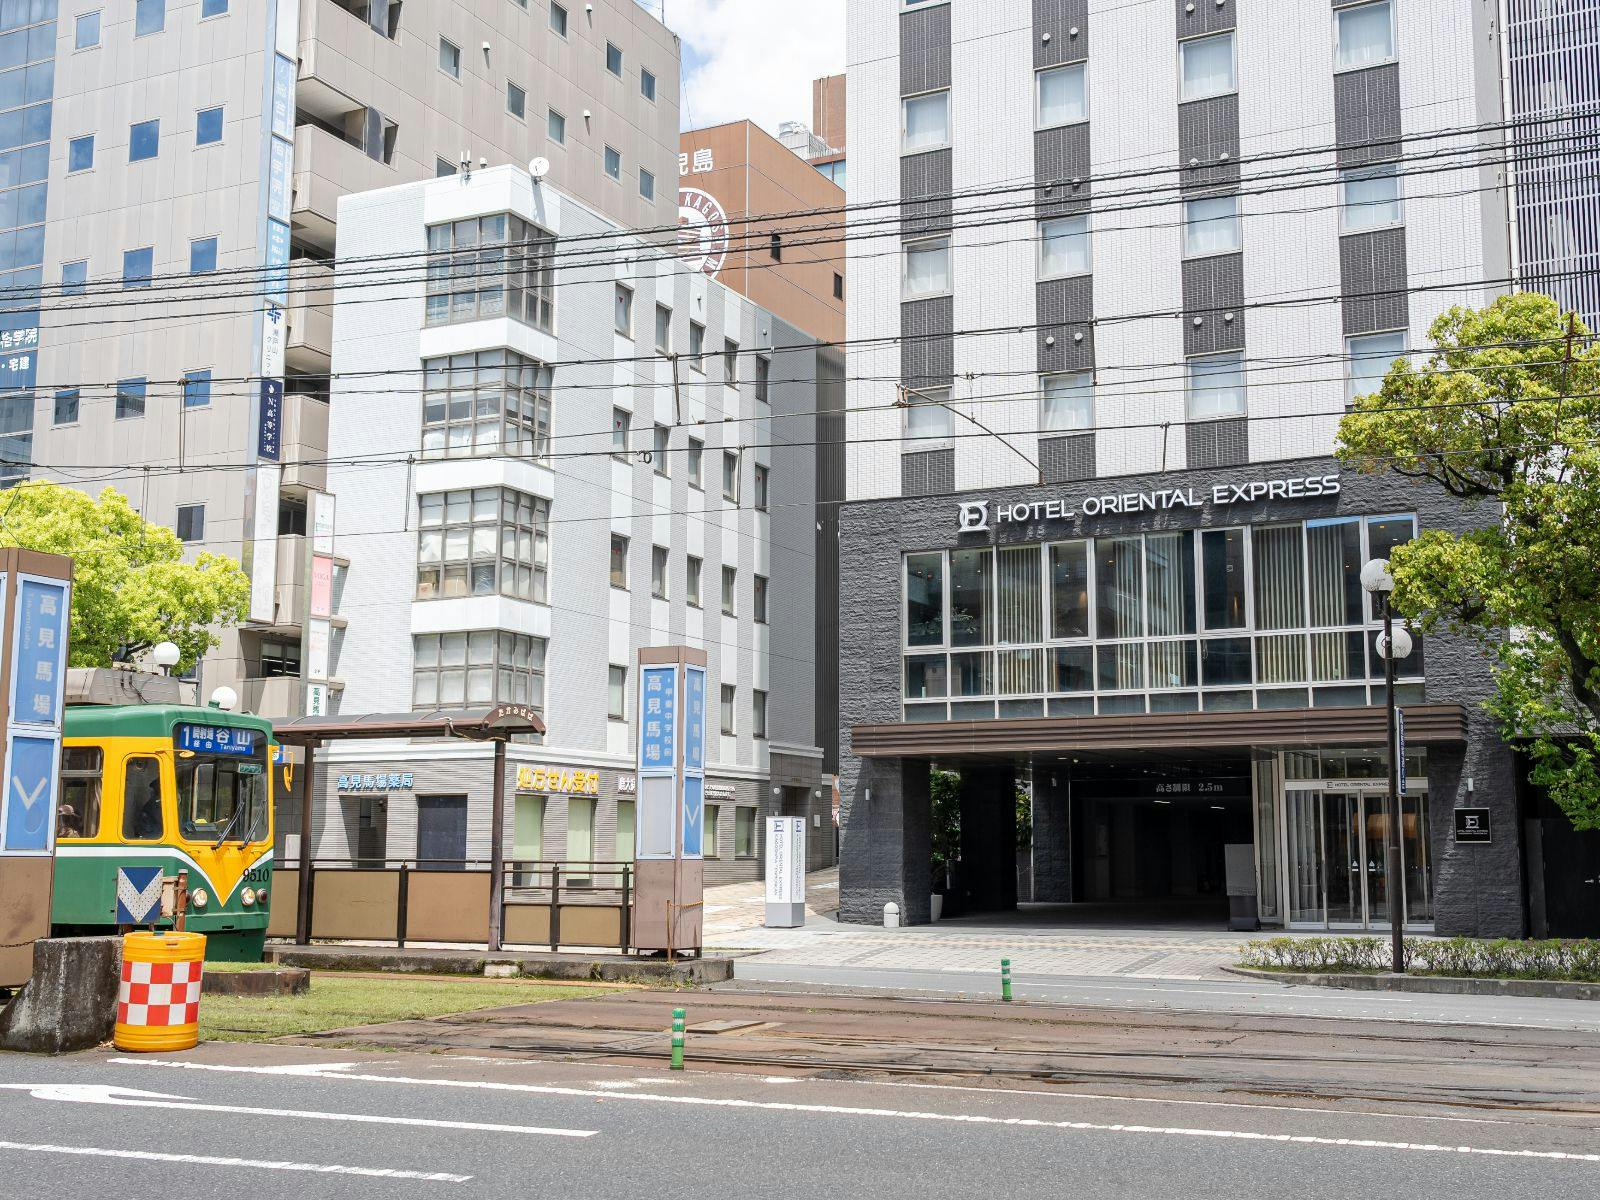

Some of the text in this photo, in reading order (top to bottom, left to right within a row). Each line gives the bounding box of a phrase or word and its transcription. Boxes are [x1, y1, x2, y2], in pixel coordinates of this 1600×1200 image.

[997, 474, 1341, 523] HOTEL ORIENTAL EXPRESS
[33, 594, 57, 716] 高見馬場
[312, 687, 321, 717] 高見馬
[498, 706, 534, 722] たかみばば
[646, 674, 663, 761] 高見馬場
[183, 725, 190, 747] 1
[215, 728, 251, 746] 谷山
[220, 743, 246, 752] Taniyama
[337, 773, 414, 789] 高見馬場薬局
[517, 766, 599, 794] 処方せん受付
[1156, 783, 1223, 793] 高さ制限 2.5m
[242, 868, 270, 883] 9510
